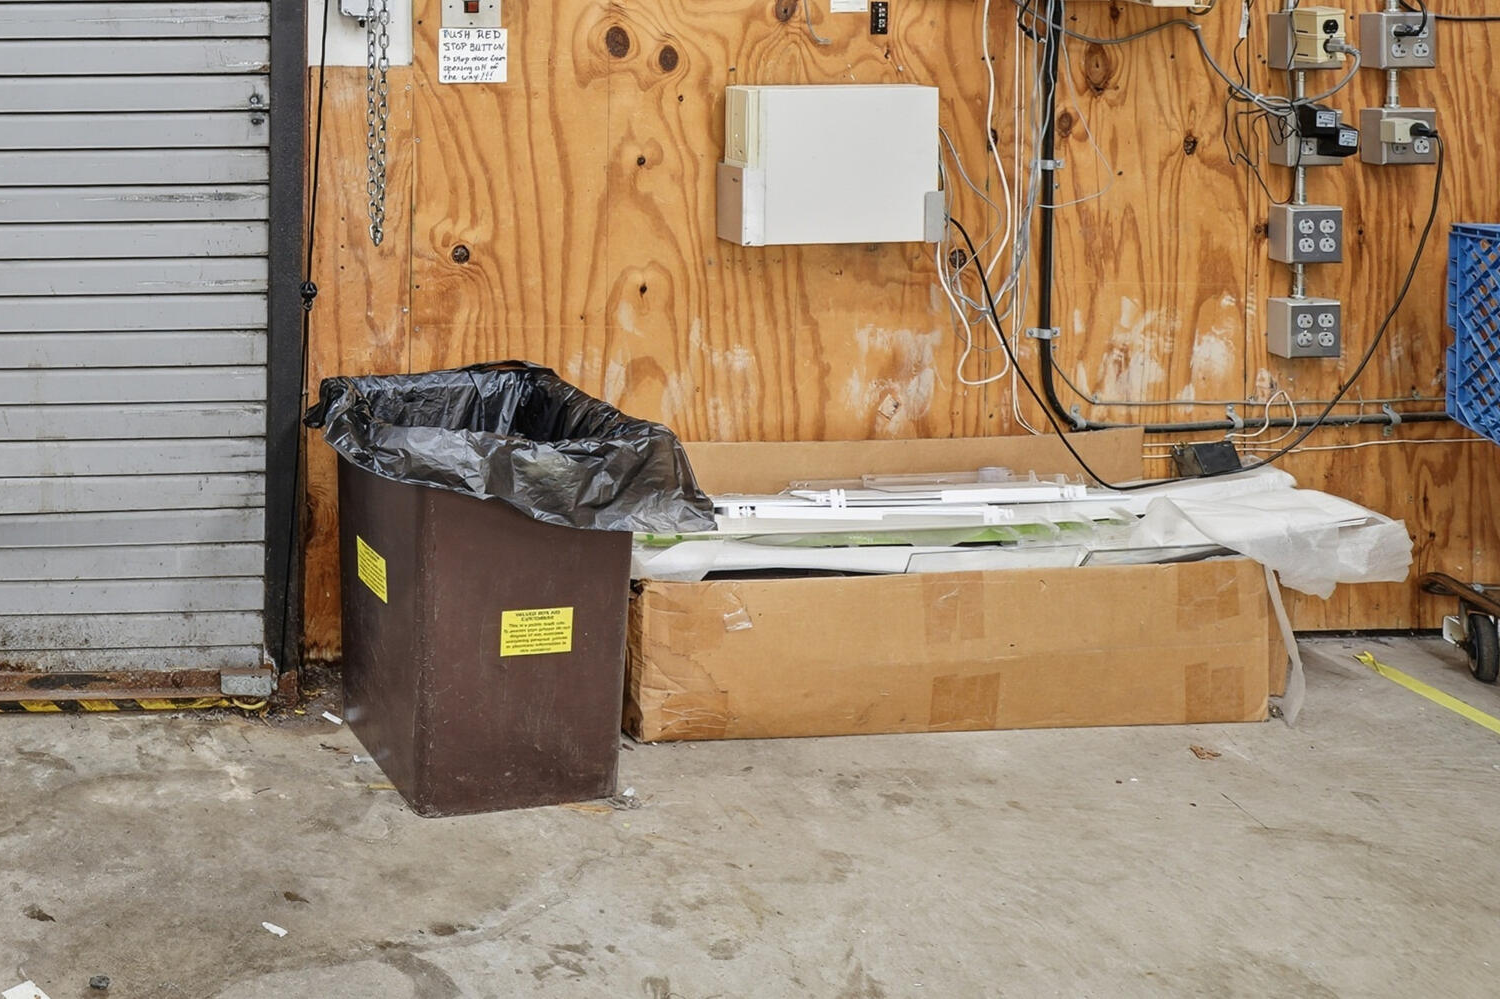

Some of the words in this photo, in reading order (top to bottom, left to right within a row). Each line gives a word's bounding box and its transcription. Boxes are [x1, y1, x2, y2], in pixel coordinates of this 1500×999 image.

[443, 30, 470, 40] PUSH
[477, 30, 501, 40] RED
[443, 43, 467, 52] STOP
[469, 43, 505, 52] BUTTON
